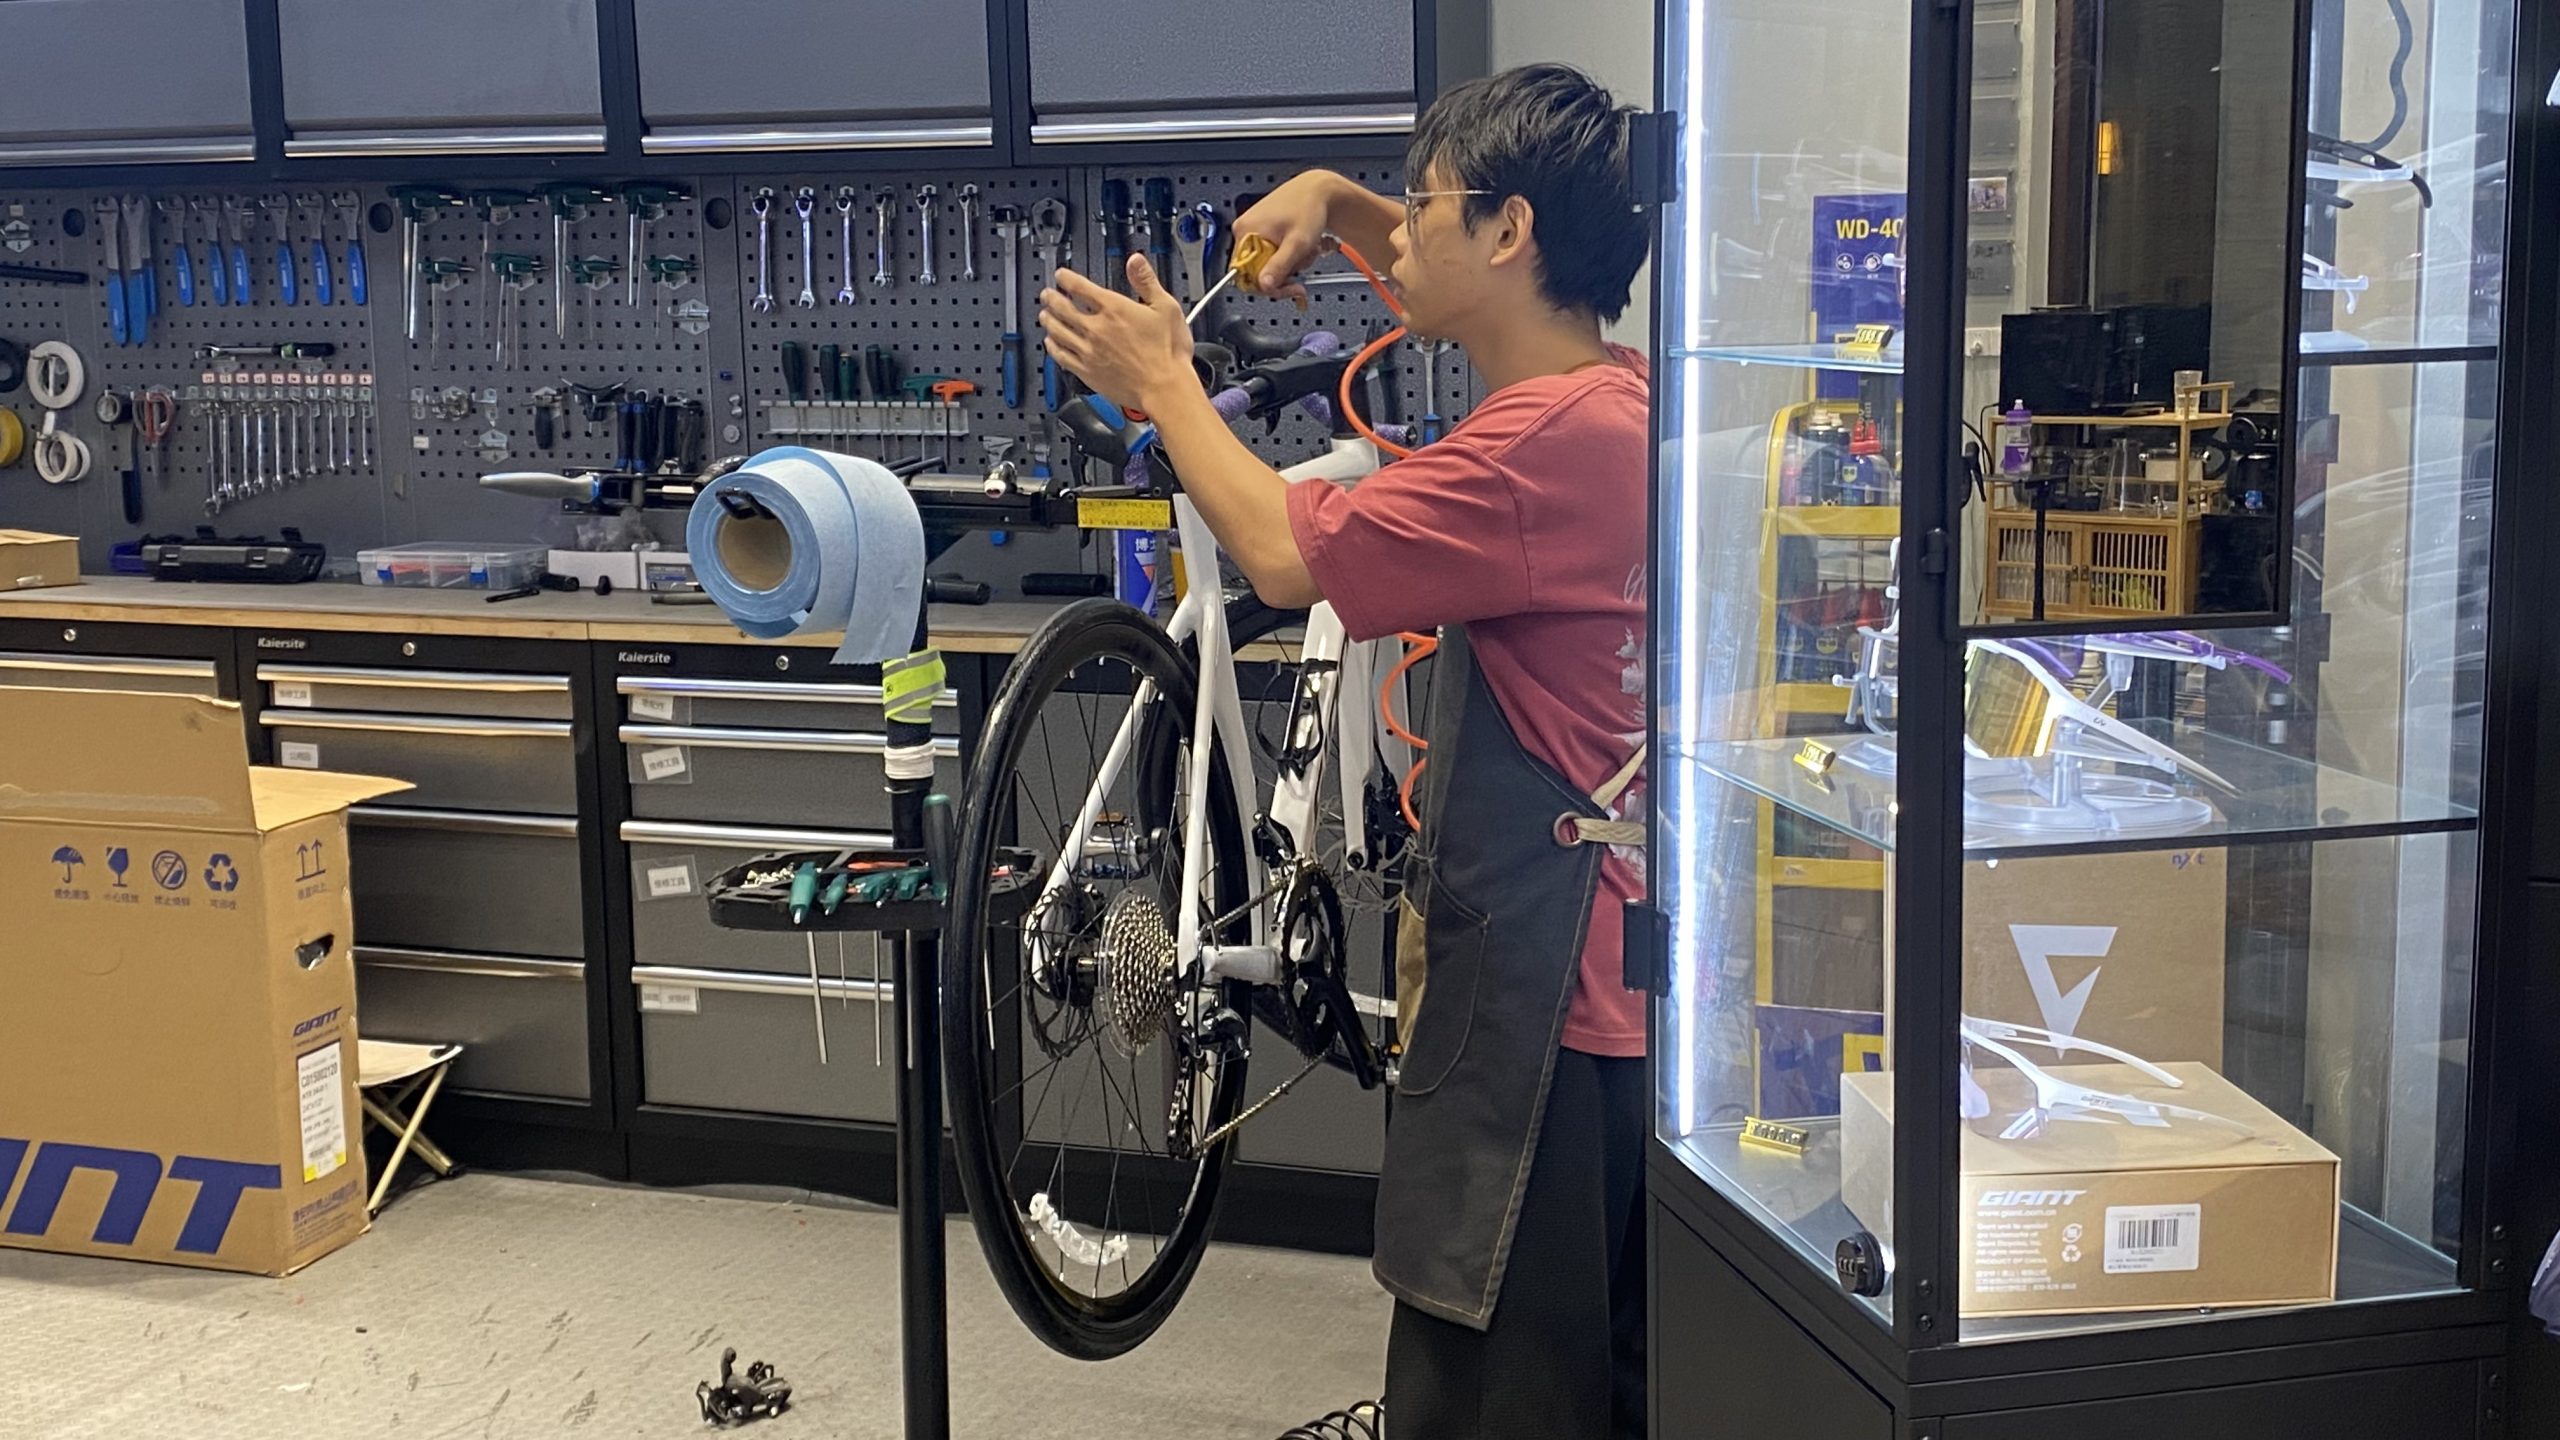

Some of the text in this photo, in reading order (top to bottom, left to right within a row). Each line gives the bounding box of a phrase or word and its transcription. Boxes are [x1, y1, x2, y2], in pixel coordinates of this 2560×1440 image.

[257, 637, 306, 649] Kaiersite
[618, 651, 671, 664] Kaiersite
[292, 1006, 342, 1037] GIANT
[1978, 1190, 2087, 1206] GIANT
